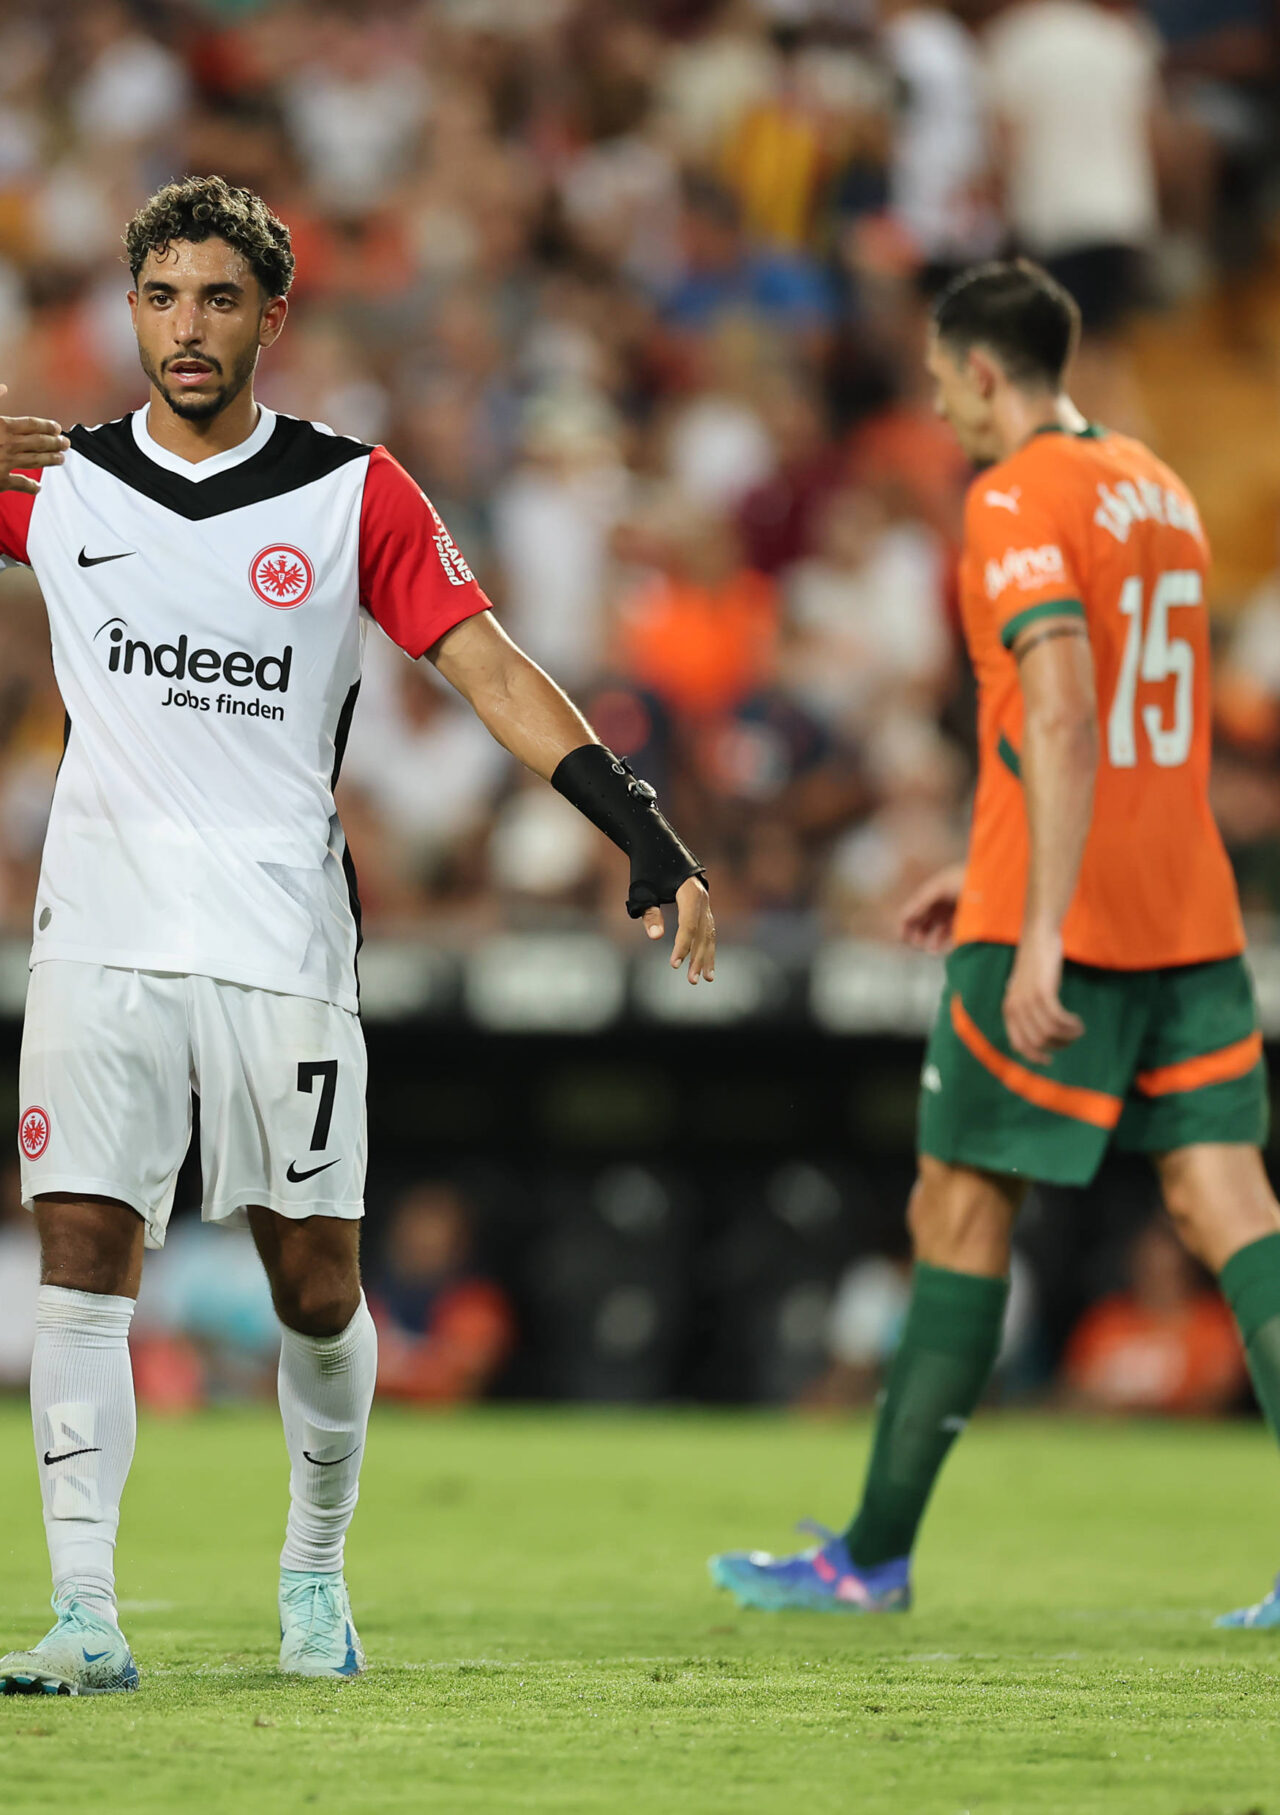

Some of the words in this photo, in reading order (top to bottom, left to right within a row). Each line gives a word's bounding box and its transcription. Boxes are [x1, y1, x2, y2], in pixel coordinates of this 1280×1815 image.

[431, 535, 466, 587] reload
[94, 617, 294, 694] indeed
[1107, 569, 1202, 768] 15
[161, 687, 211, 712] Jobs
[215, 693, 285, 722] finden
[296, 1059, 338, 1152] 7
